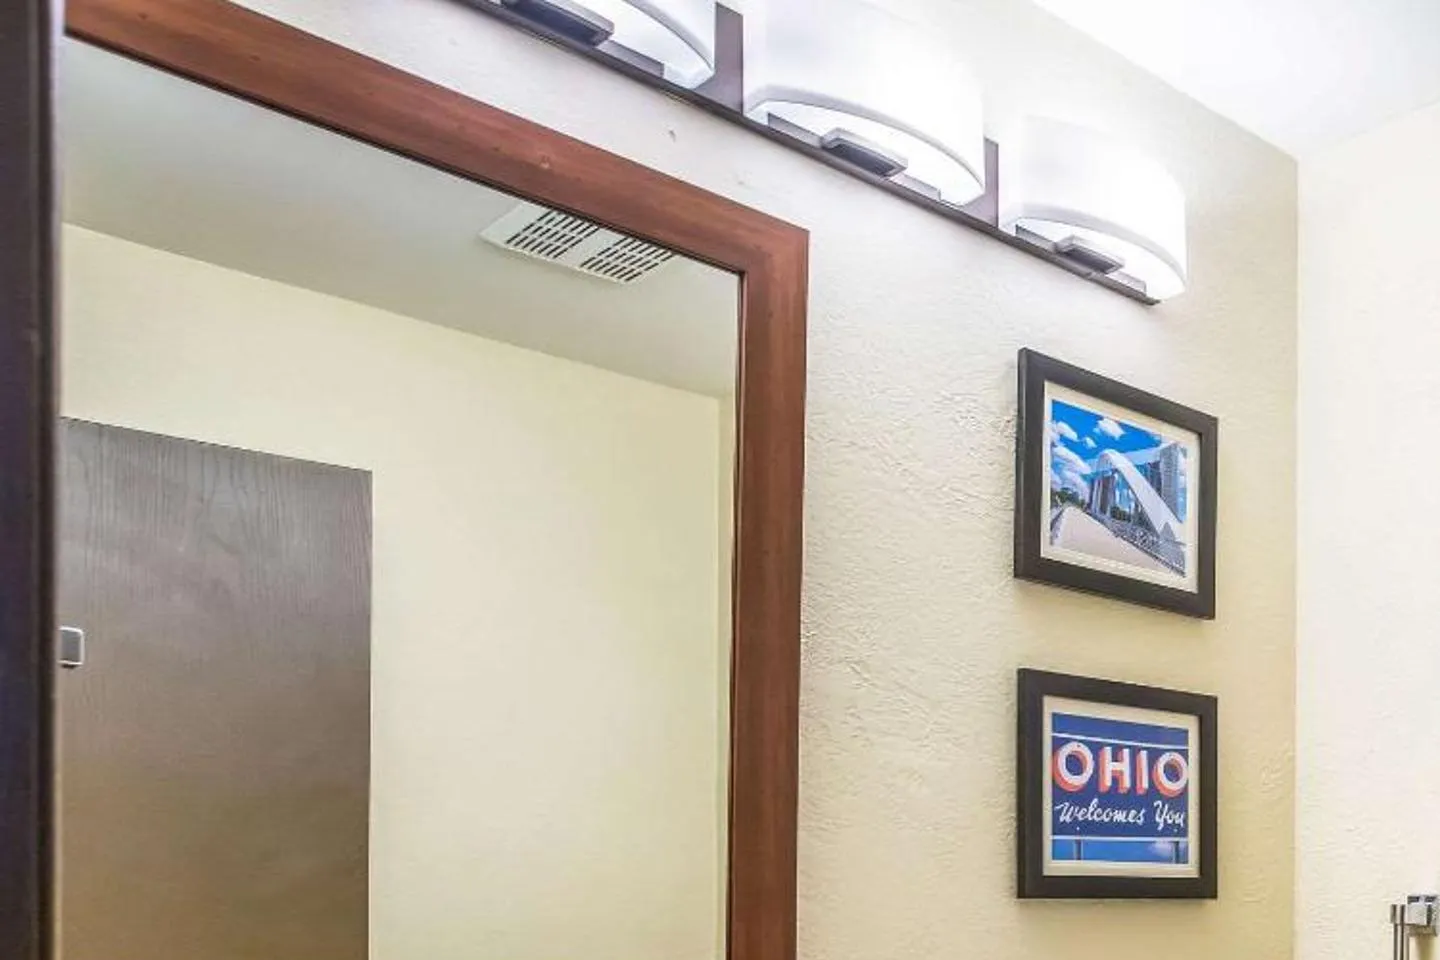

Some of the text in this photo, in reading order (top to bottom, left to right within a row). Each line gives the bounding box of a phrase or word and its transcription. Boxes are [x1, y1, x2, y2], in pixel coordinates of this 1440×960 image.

[1052, 741, 1188, 797] OHIO
[1054, 798, 1185, 831] Welcomes You
